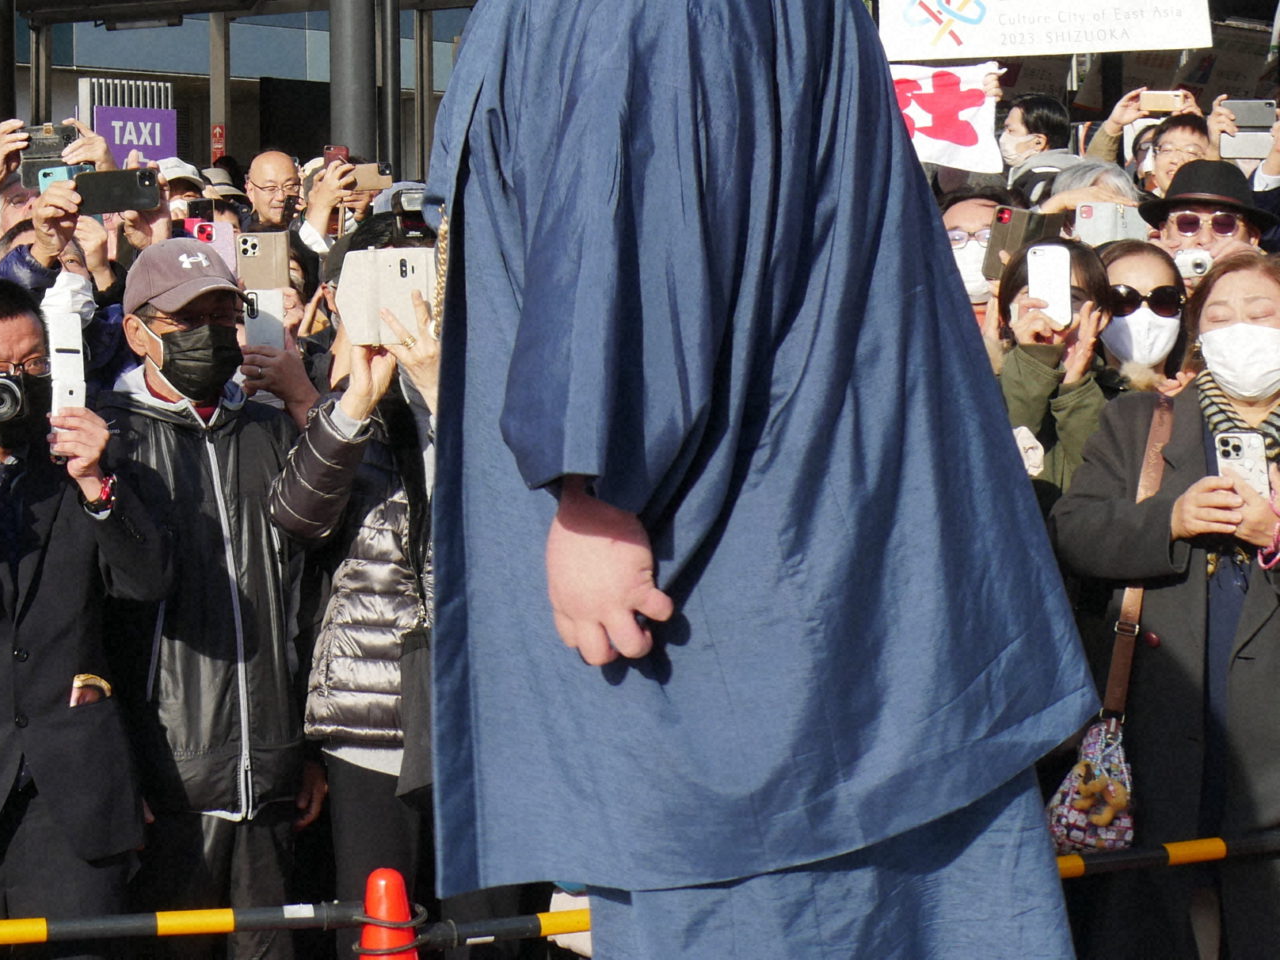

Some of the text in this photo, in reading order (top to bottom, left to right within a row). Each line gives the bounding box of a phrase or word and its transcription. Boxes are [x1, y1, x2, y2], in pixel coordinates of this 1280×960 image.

[999, 13, 1052, 26] Culture
[1058, 10, 1086, 24] City
[1114, 7, 1145, 21] East
[1152, 6, 1182, 18] Asia
[1045, 27, 1130, 44] SHIZUOKA
[111, 120, 161, 146] TAXI
